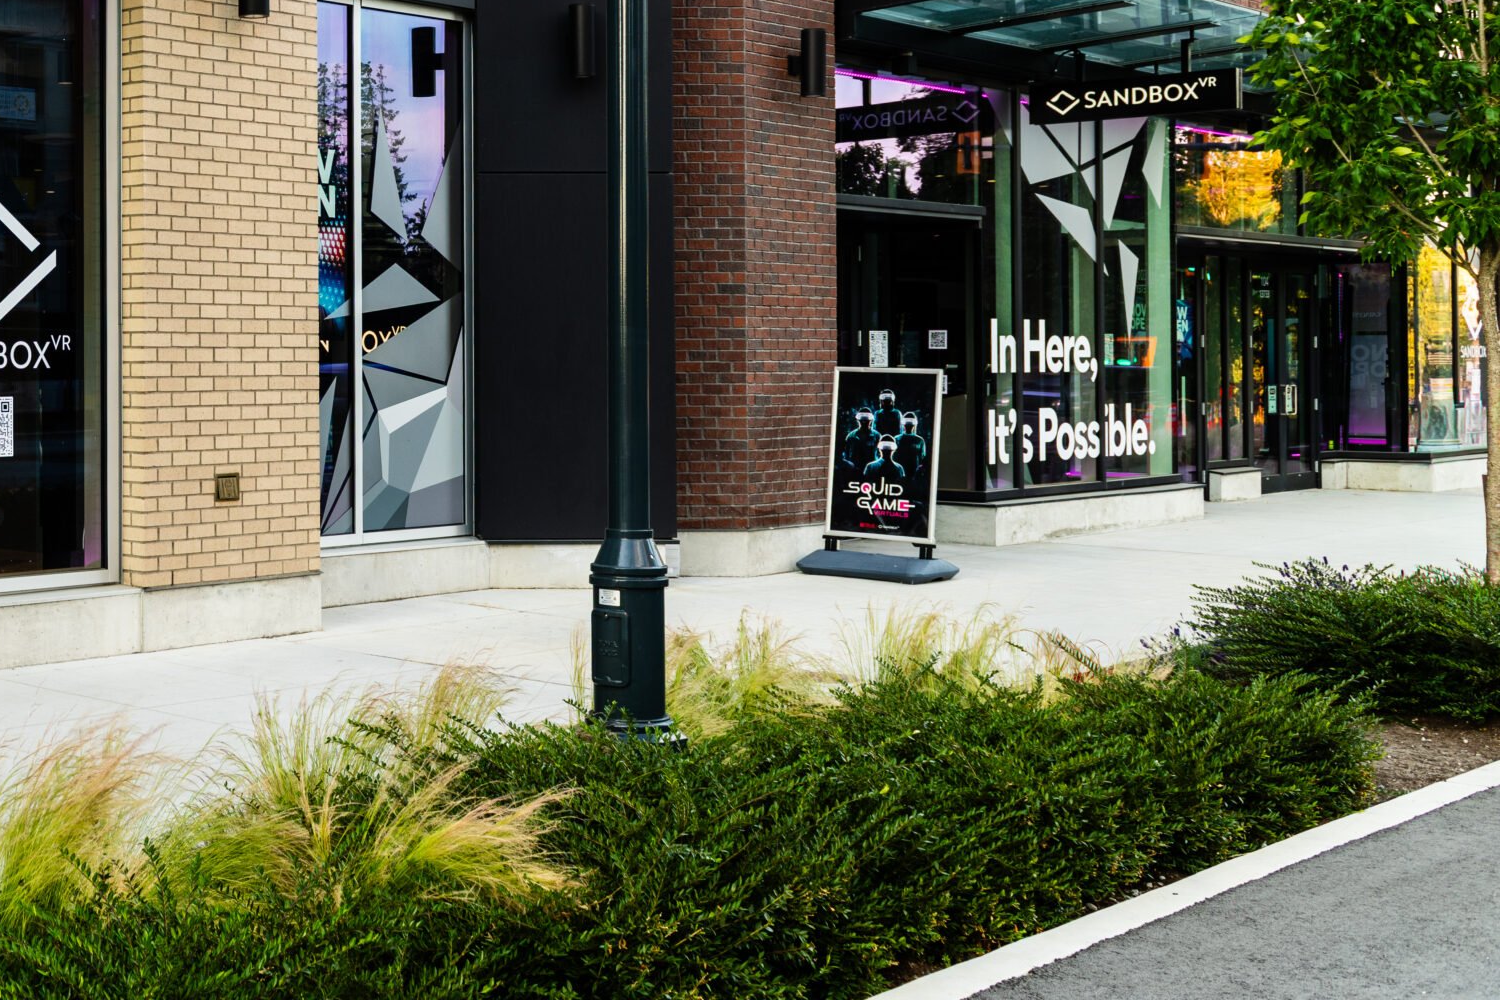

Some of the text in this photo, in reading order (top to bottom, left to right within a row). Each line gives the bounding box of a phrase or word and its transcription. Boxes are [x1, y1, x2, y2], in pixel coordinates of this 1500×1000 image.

[1084, 81, 1199, 109] SANDBOX
[990, 318, 1098, 383] In Here,
[1038, 402, 1156, 462] Possible.
[843, 477, 903, 499] SQUID
[857, 497, 915, 515] GAME
